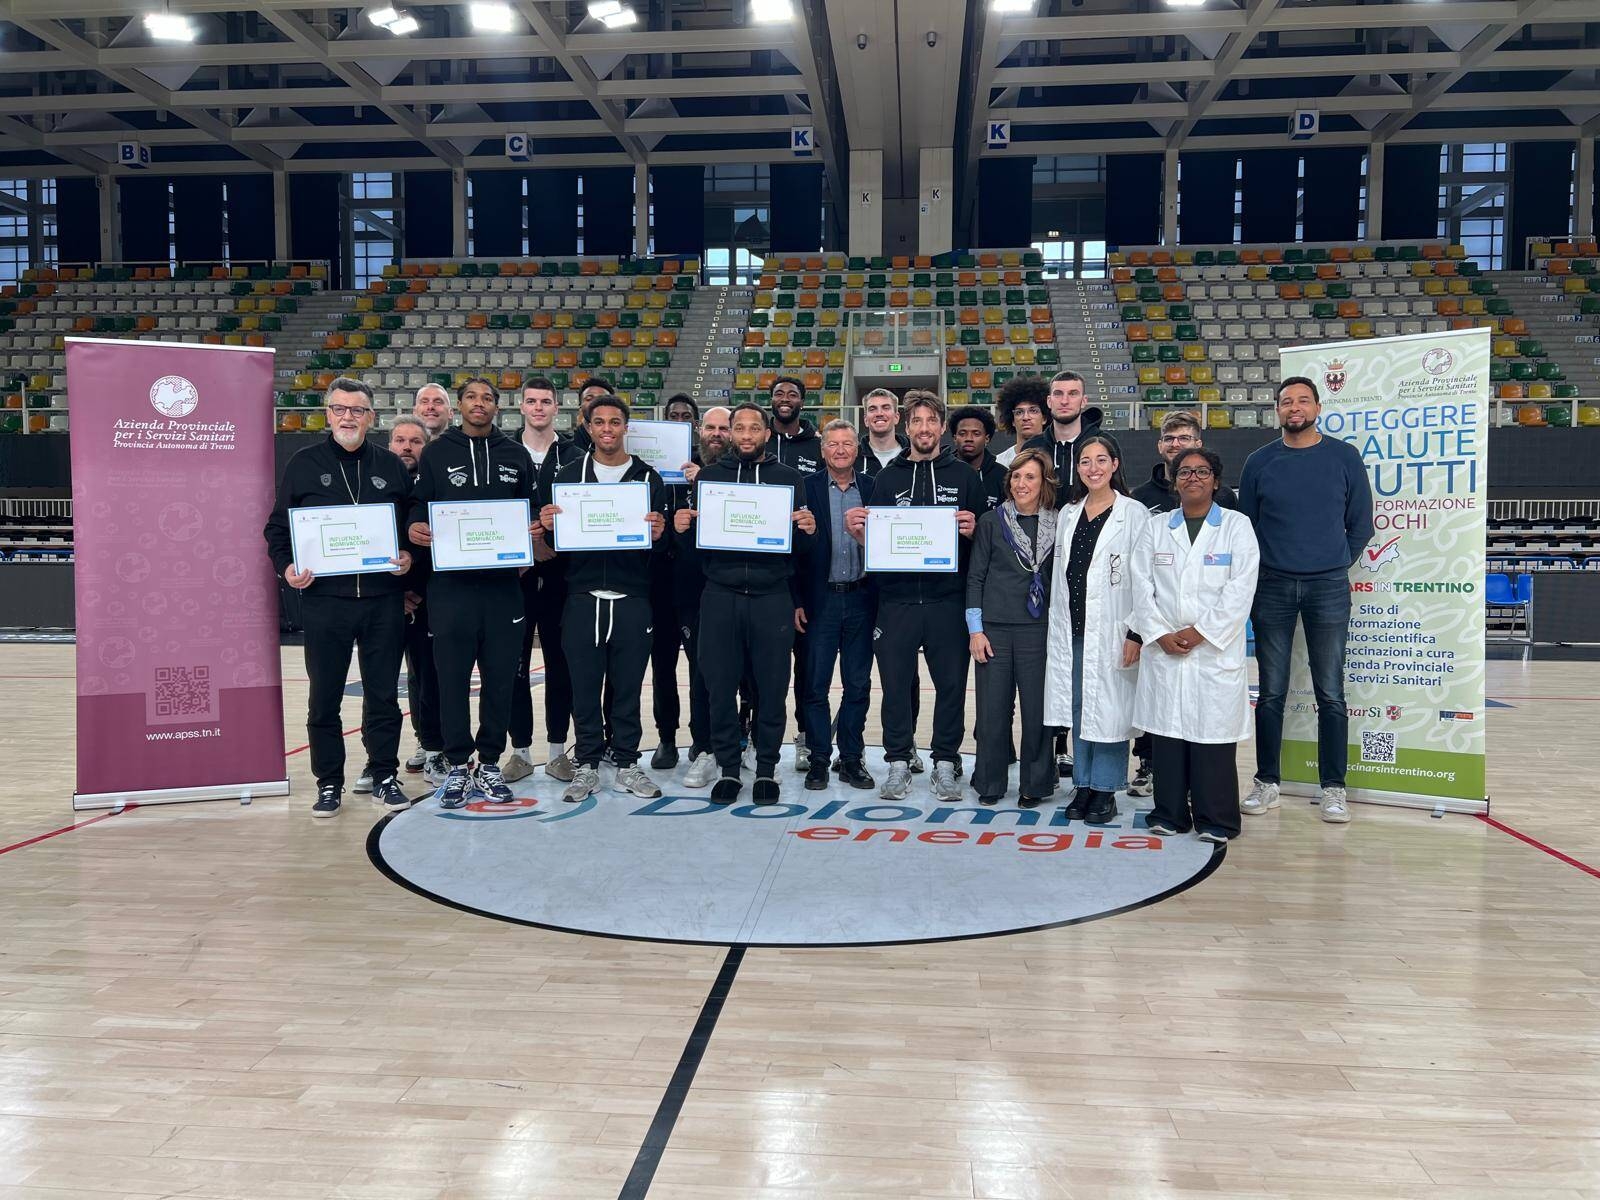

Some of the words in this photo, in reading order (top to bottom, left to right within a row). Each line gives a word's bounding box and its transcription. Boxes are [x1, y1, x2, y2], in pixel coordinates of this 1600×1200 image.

[1299, 113, 1315, 130] D
[793, 130, 810, 147] K
[990, 123, 1006, 140] K
[508, 136, 524, 153] C
[121, 144, 135, 160] B
[862, 193, 869, 202] K
[932, 189, 940, 199] K
[1399, 378, 1430, 388] Azienda
[1431, 374, 1478, 385] Provinciale
[1417, 383, 1445, 393] Servizi
[1446, 381, 1478, 391] Sanitari
[113, 418, 165, 430] Azienda
[167, 420, 236, 432] Provinciale
[1315, 404, 1477, 434] ROTEGGERE
[113, 430, 135, 442] per
[137, 430, 143, 440] i
[145, 430, 187, 441] Servizi
[189, 431, 236, 442] Sanitari
[113, 440, 154, 449] Provincia
[155, 441, 198, 450] Autonoma
[199, 442, 208, 450] di
[210, 442, 235, 450] Trento
[1365, 459, 1477, 497] UTTI
[1374, 497, 1477, 512] FORMAZIONE
[1373, 513, 1428, 530] OCHI
[1360, 604, 1384, 615] Sito
[1387, 604, 1399, 615] di
[1350, 618, 1421, 630] formazione
[1345, 646, 1412, 658] accinazioni
[1416, 650, 1423, 658] a
[1426, 649, 1455, 659] cura
[1383, 660, 1454, 673] Provinciale
[1348, 673, 1389, 684] Servizi
[1393, 675, 1442, 687] Sanitari
[145, 727, 221, 741] www.apss.tn.it
[1305, 760, 1456, 782] wwccinarsintrentino.org
[788, 824, 1163, 852] energia
